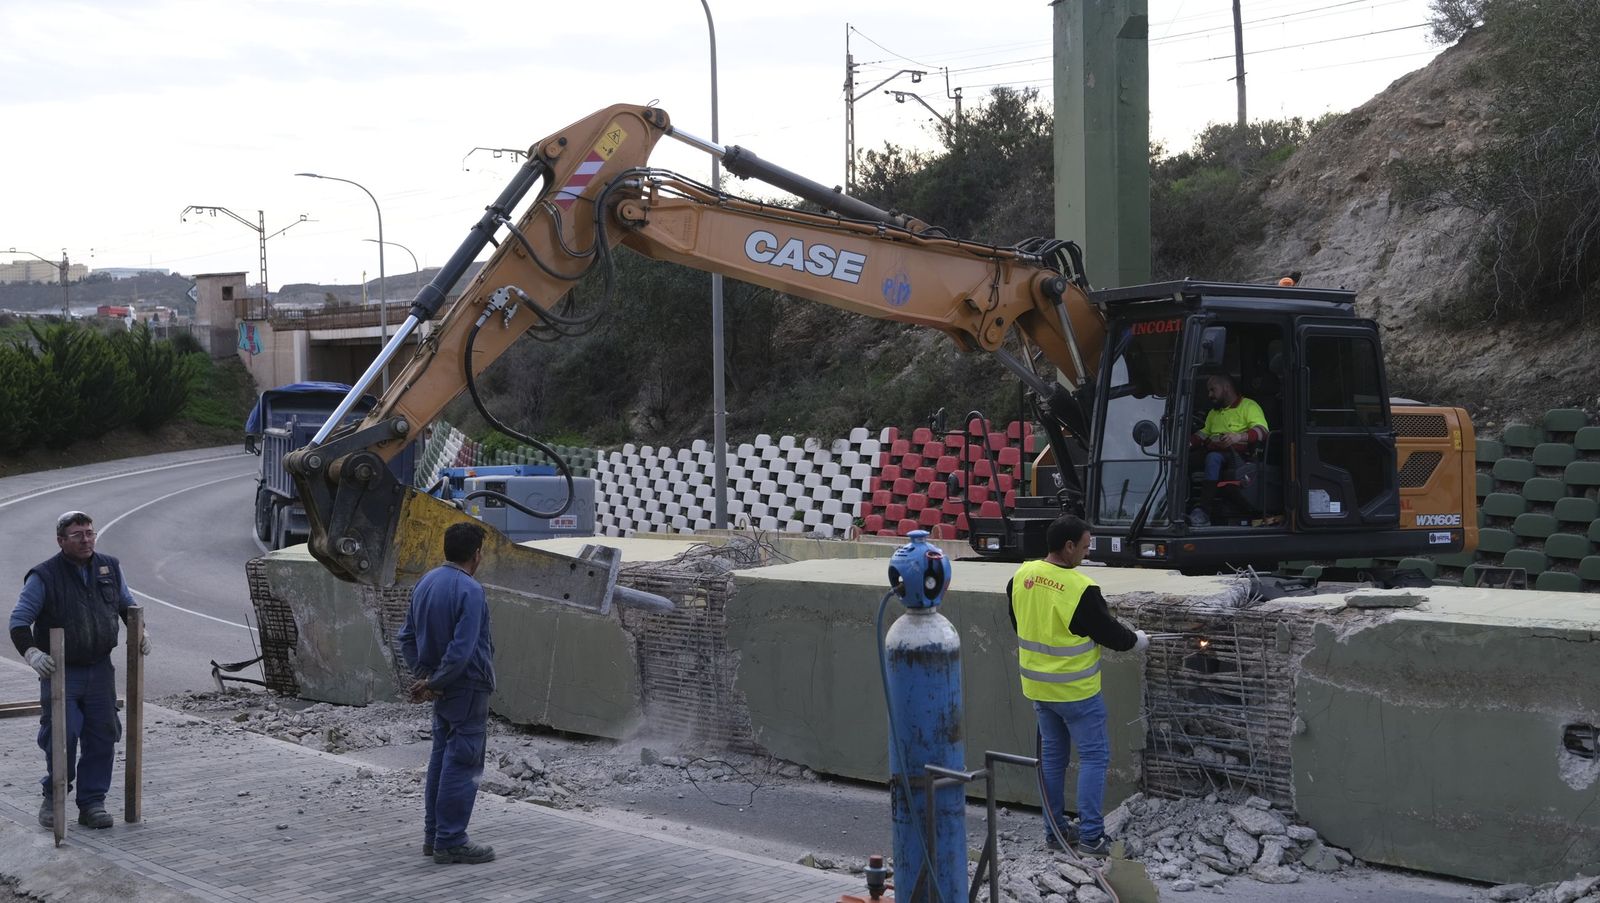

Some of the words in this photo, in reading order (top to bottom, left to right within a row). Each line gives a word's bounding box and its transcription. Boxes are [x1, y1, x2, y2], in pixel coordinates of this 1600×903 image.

[744, 229, 867, 285] CASE
[1415, 514, 1461, 526] WX160E
[1035, 575, 1065, 592] INCOAL
